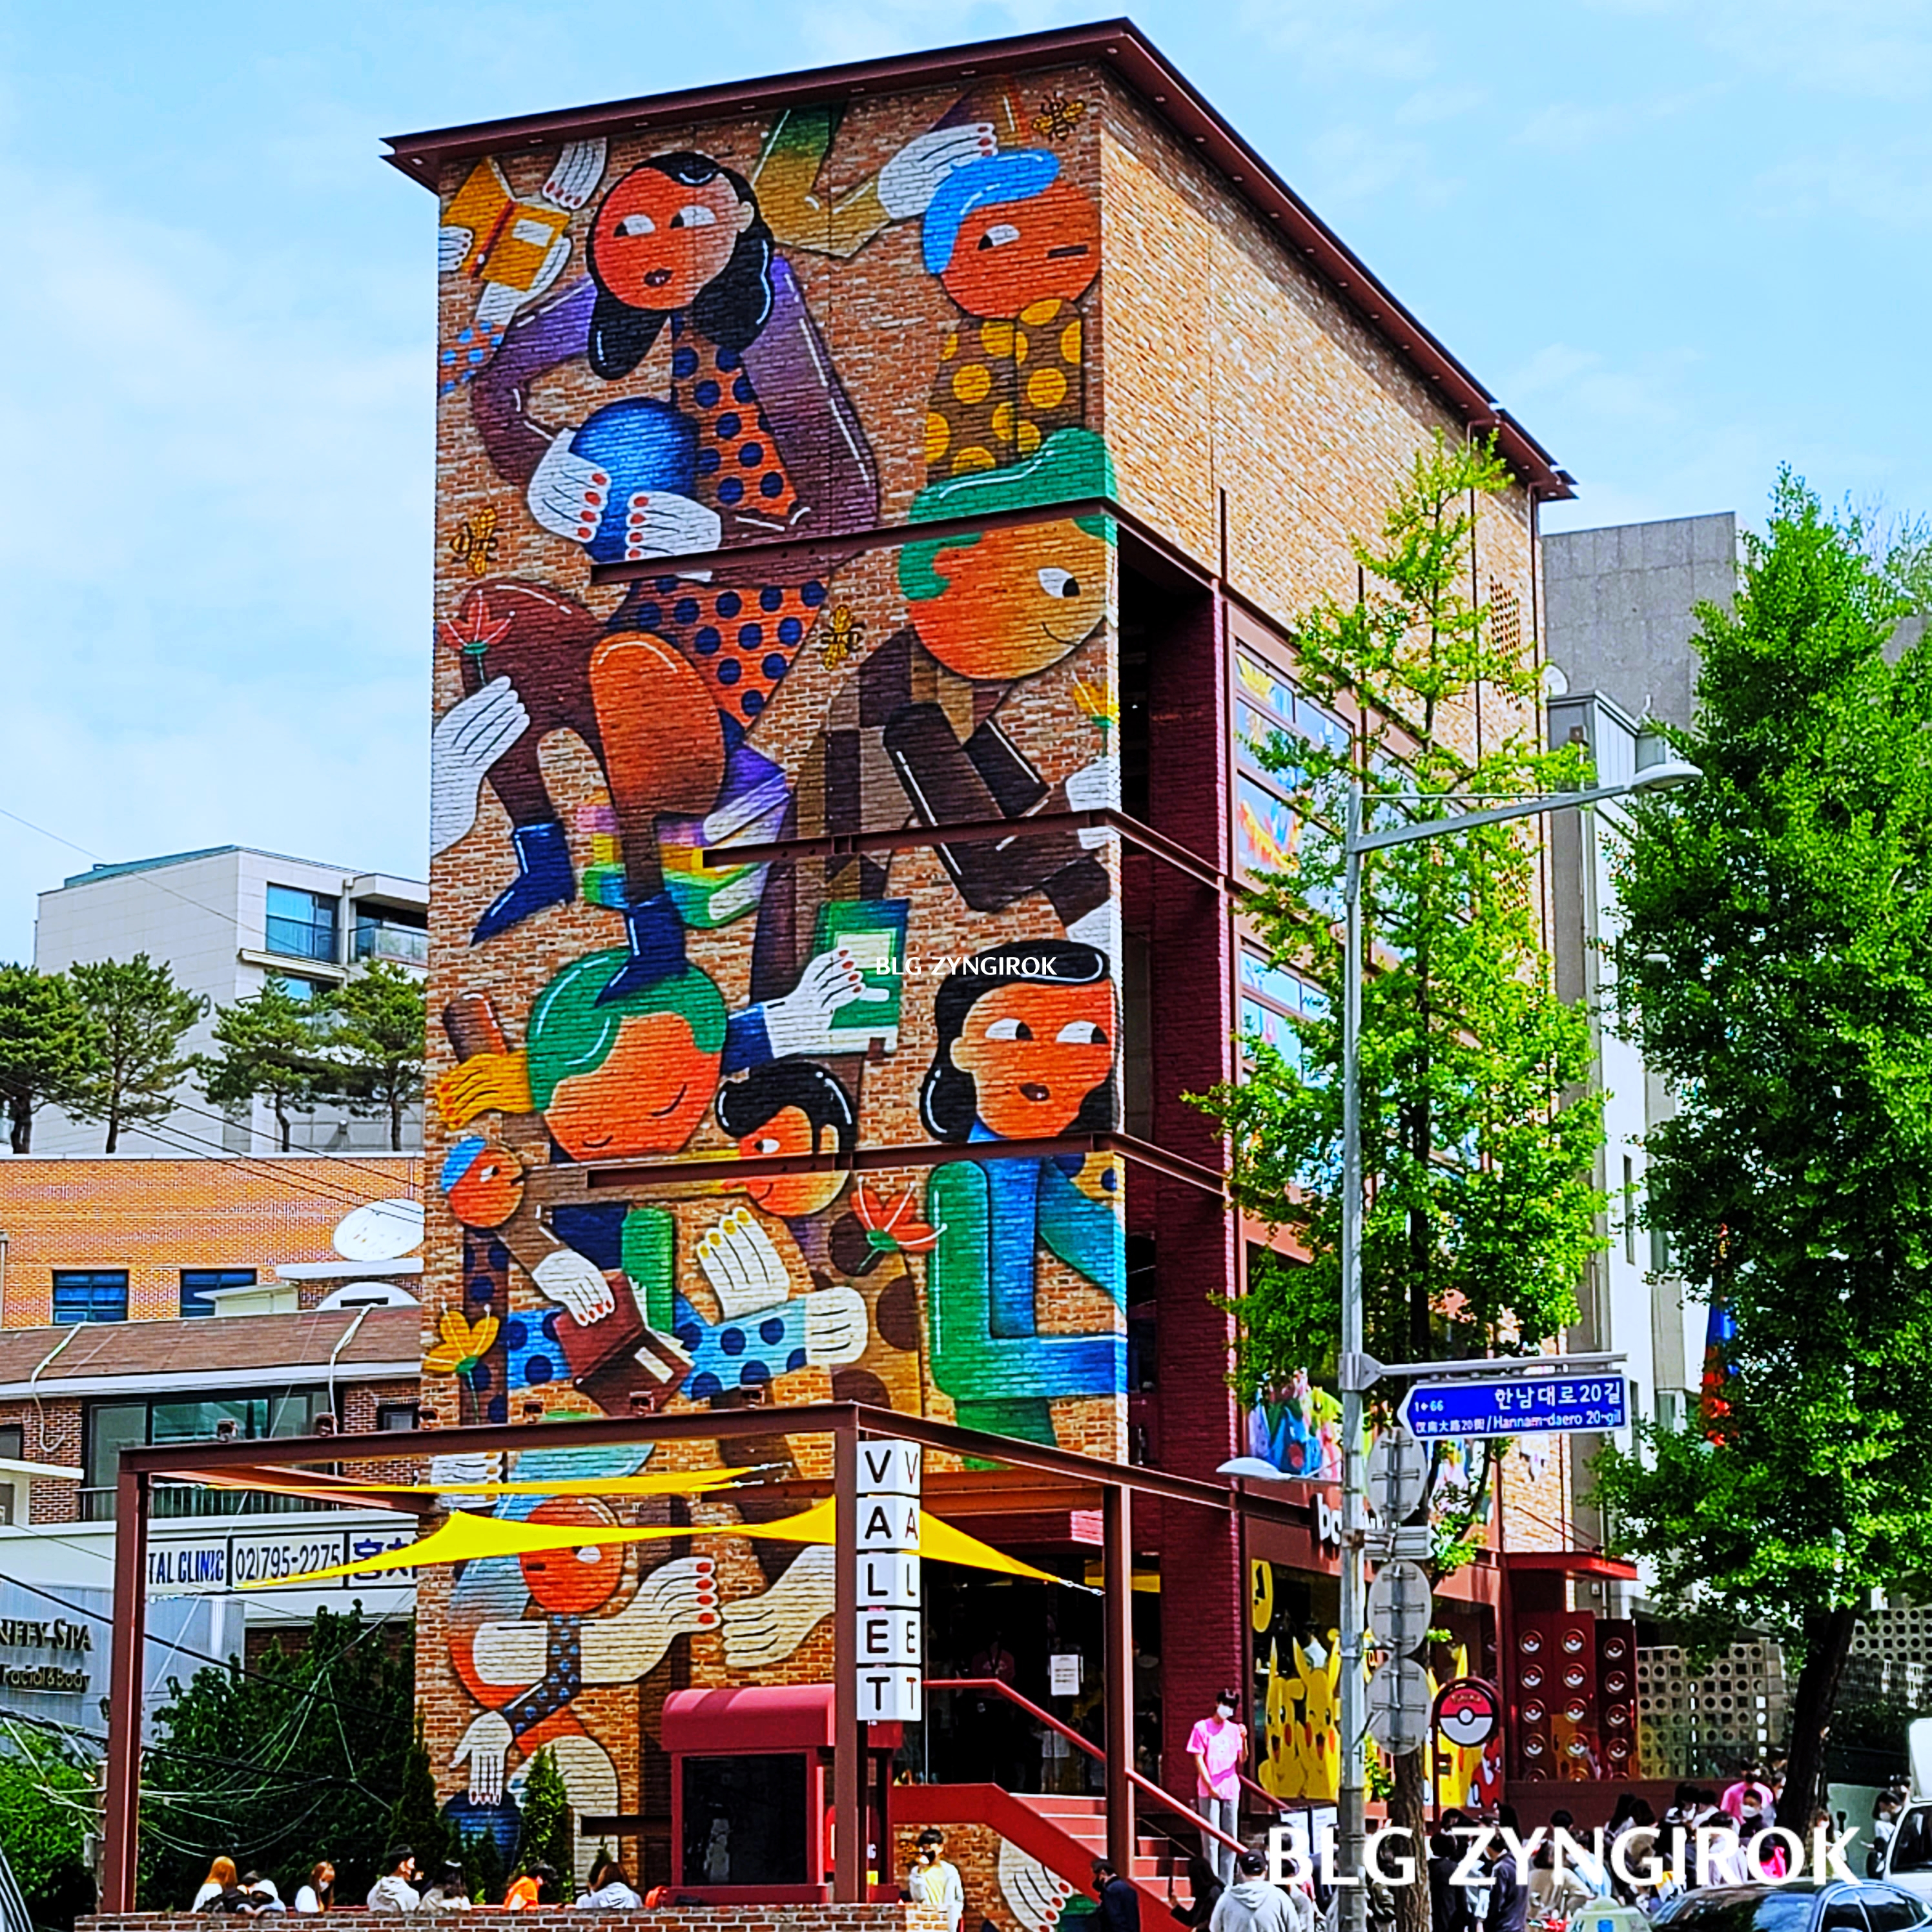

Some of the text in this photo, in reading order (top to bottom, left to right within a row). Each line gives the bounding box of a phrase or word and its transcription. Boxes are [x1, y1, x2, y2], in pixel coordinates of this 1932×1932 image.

[1495, 1381, 1621, 1410] 한남대로20길
[1587, 1409, 1621, 1426] 20-gil
[178, 1549, 225, 1583] CLINIC
[865, 1449, 892, 1711] VALET
